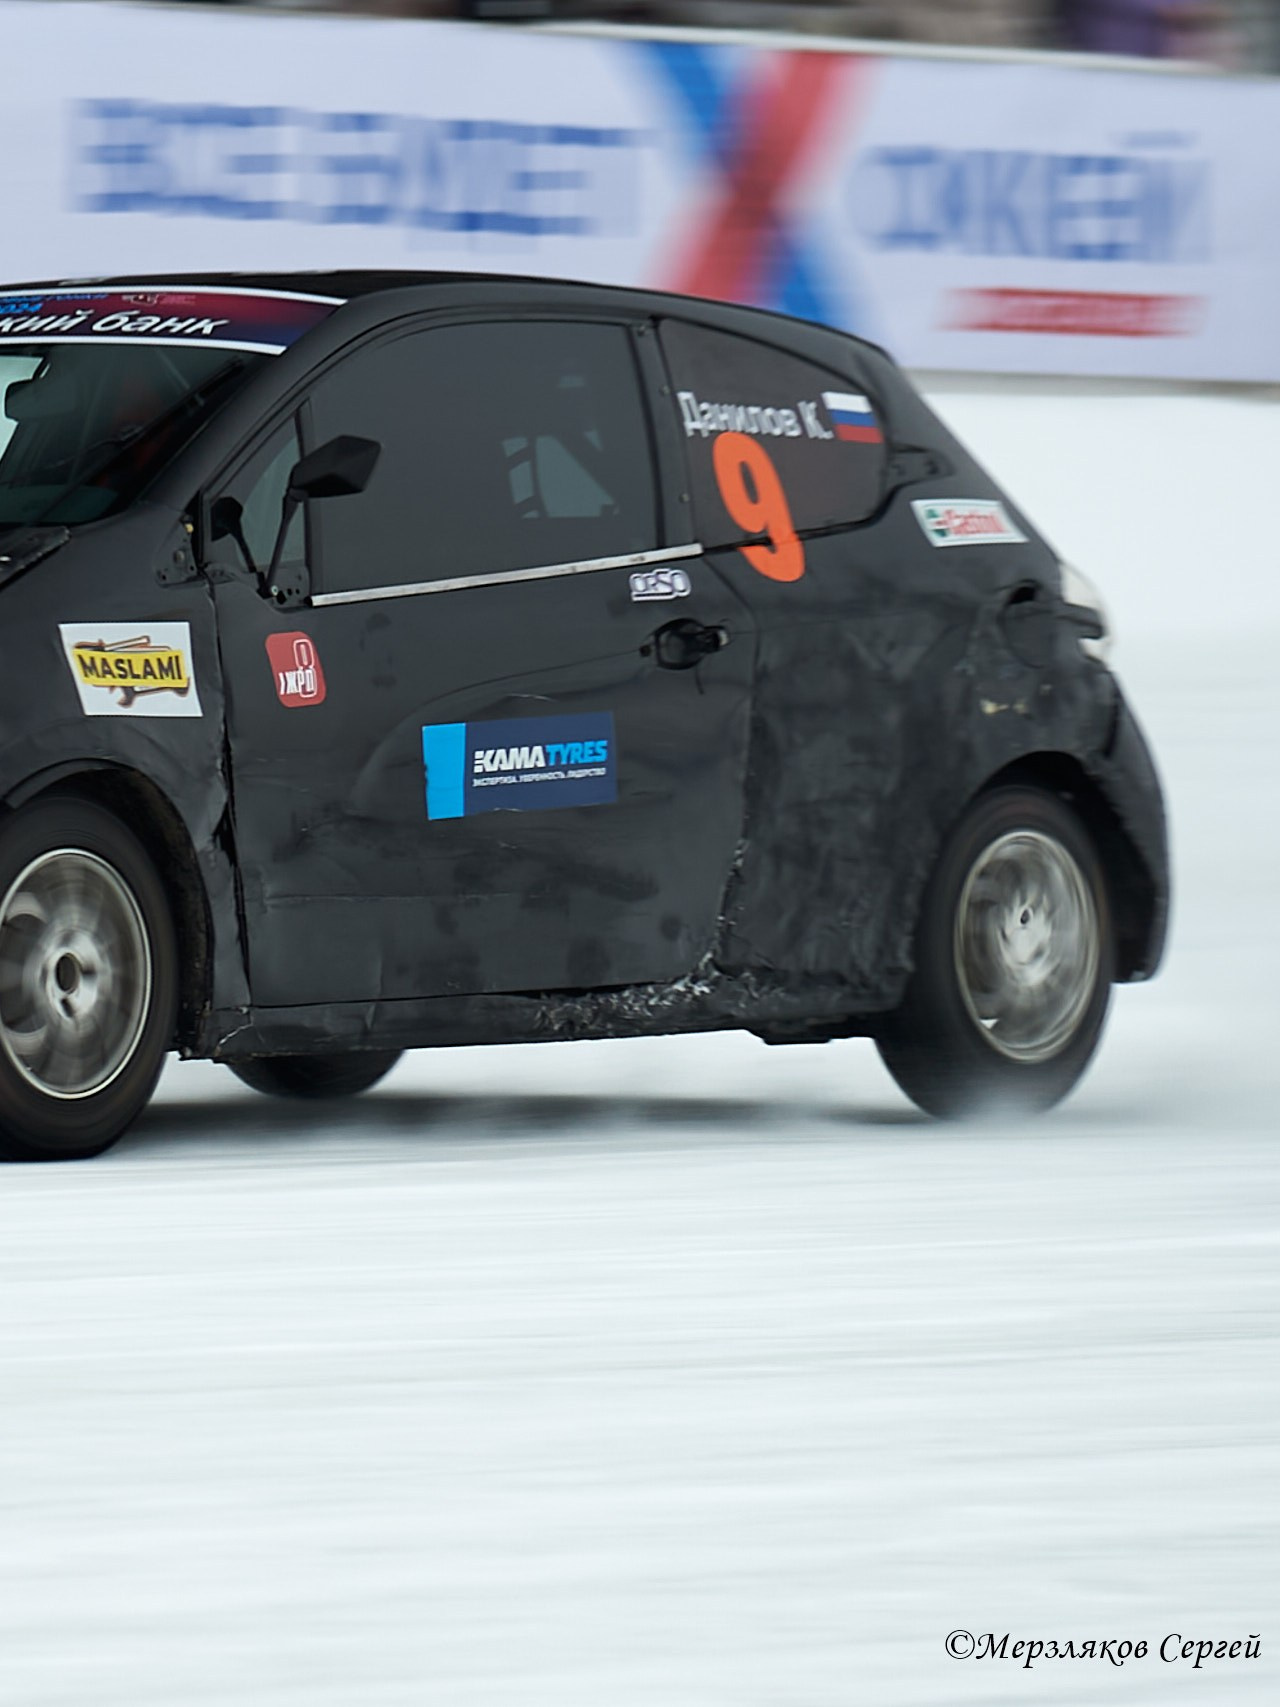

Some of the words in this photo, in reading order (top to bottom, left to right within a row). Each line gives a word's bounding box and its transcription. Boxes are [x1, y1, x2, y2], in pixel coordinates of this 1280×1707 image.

[92, 310, 230, 335] банк
[676, 391, 801, 438] Данилов
[713, 432, 805, 582] 9
[77, 653, 183, 680] MASLAMI
[473, 745, 546, 774] KAMA
[545, 740, 608, 767] TYRES
